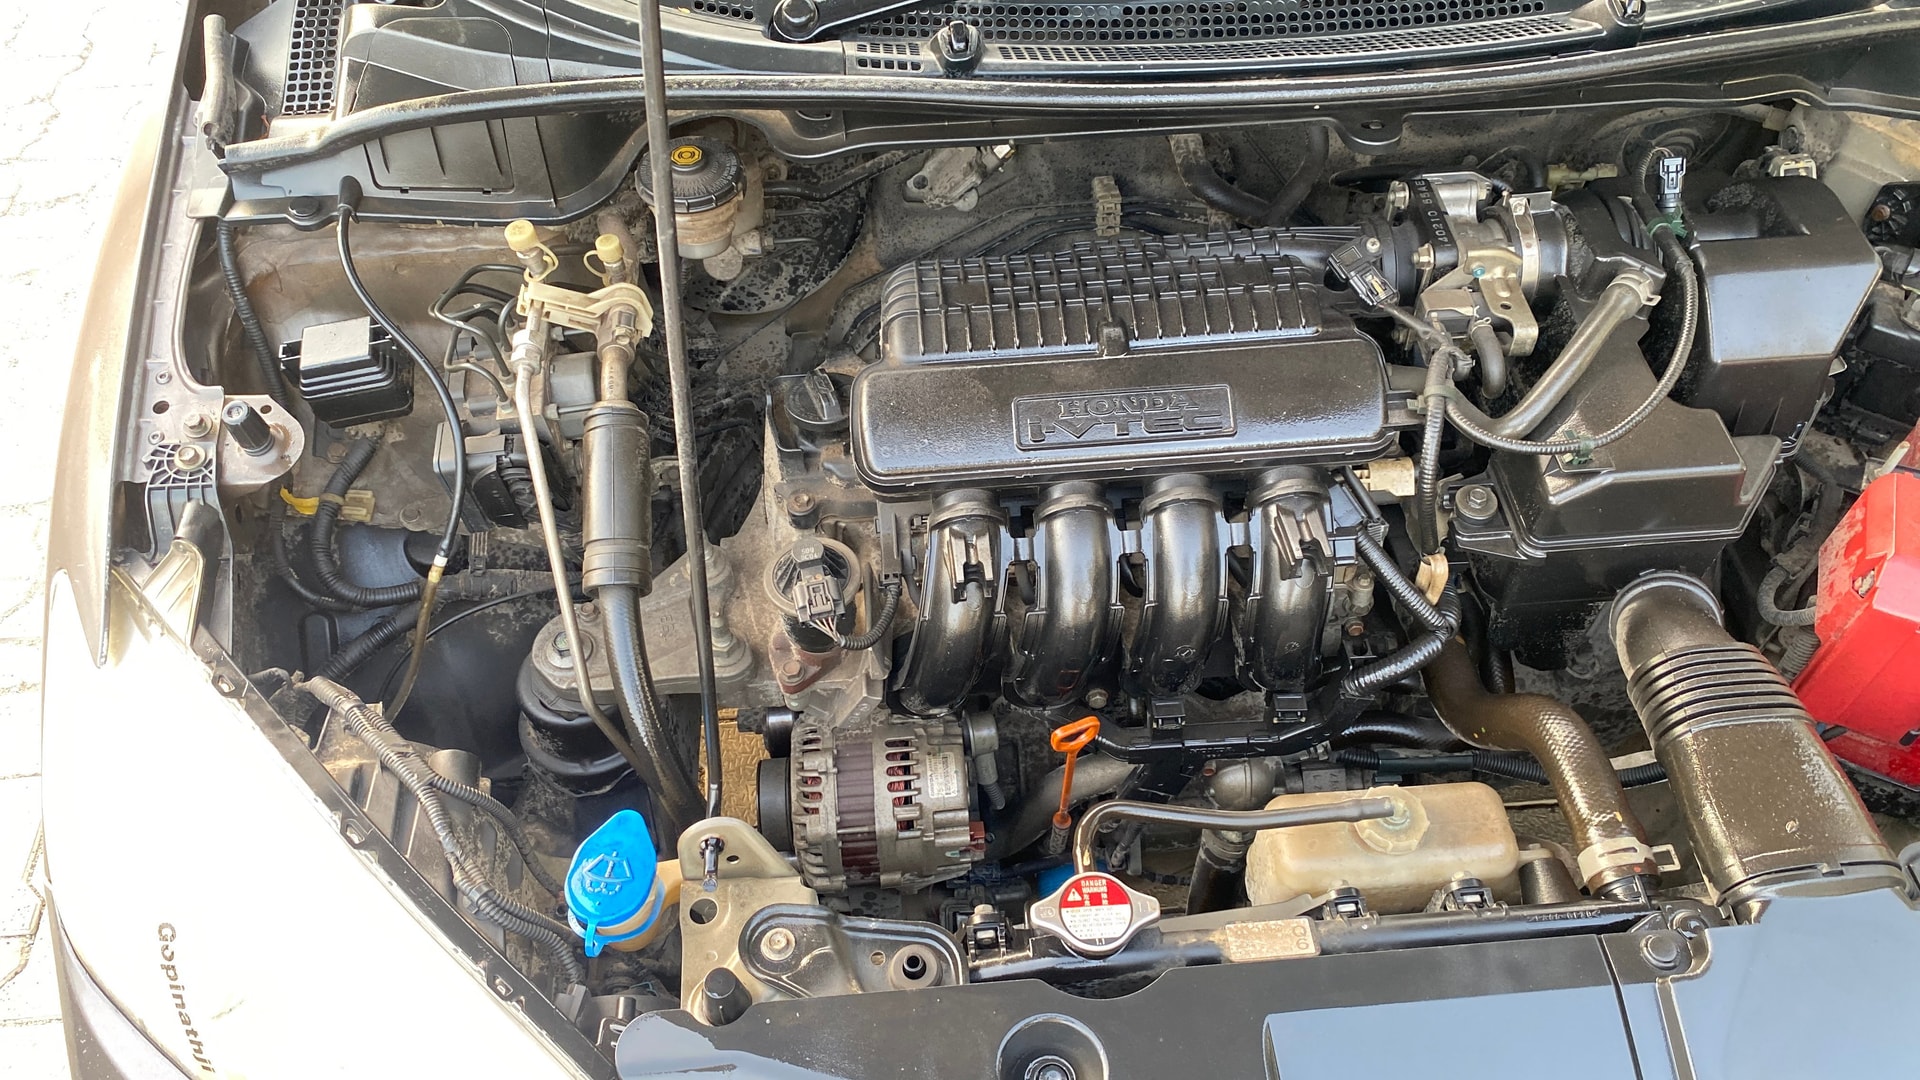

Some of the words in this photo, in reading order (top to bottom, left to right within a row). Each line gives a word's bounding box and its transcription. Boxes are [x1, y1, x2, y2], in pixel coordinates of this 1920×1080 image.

[1058, 392, 1199, 419] HONDA
[1081, 879, 1107, 887] DANGER
[158, 922, 216, 1073] Gopinathji
